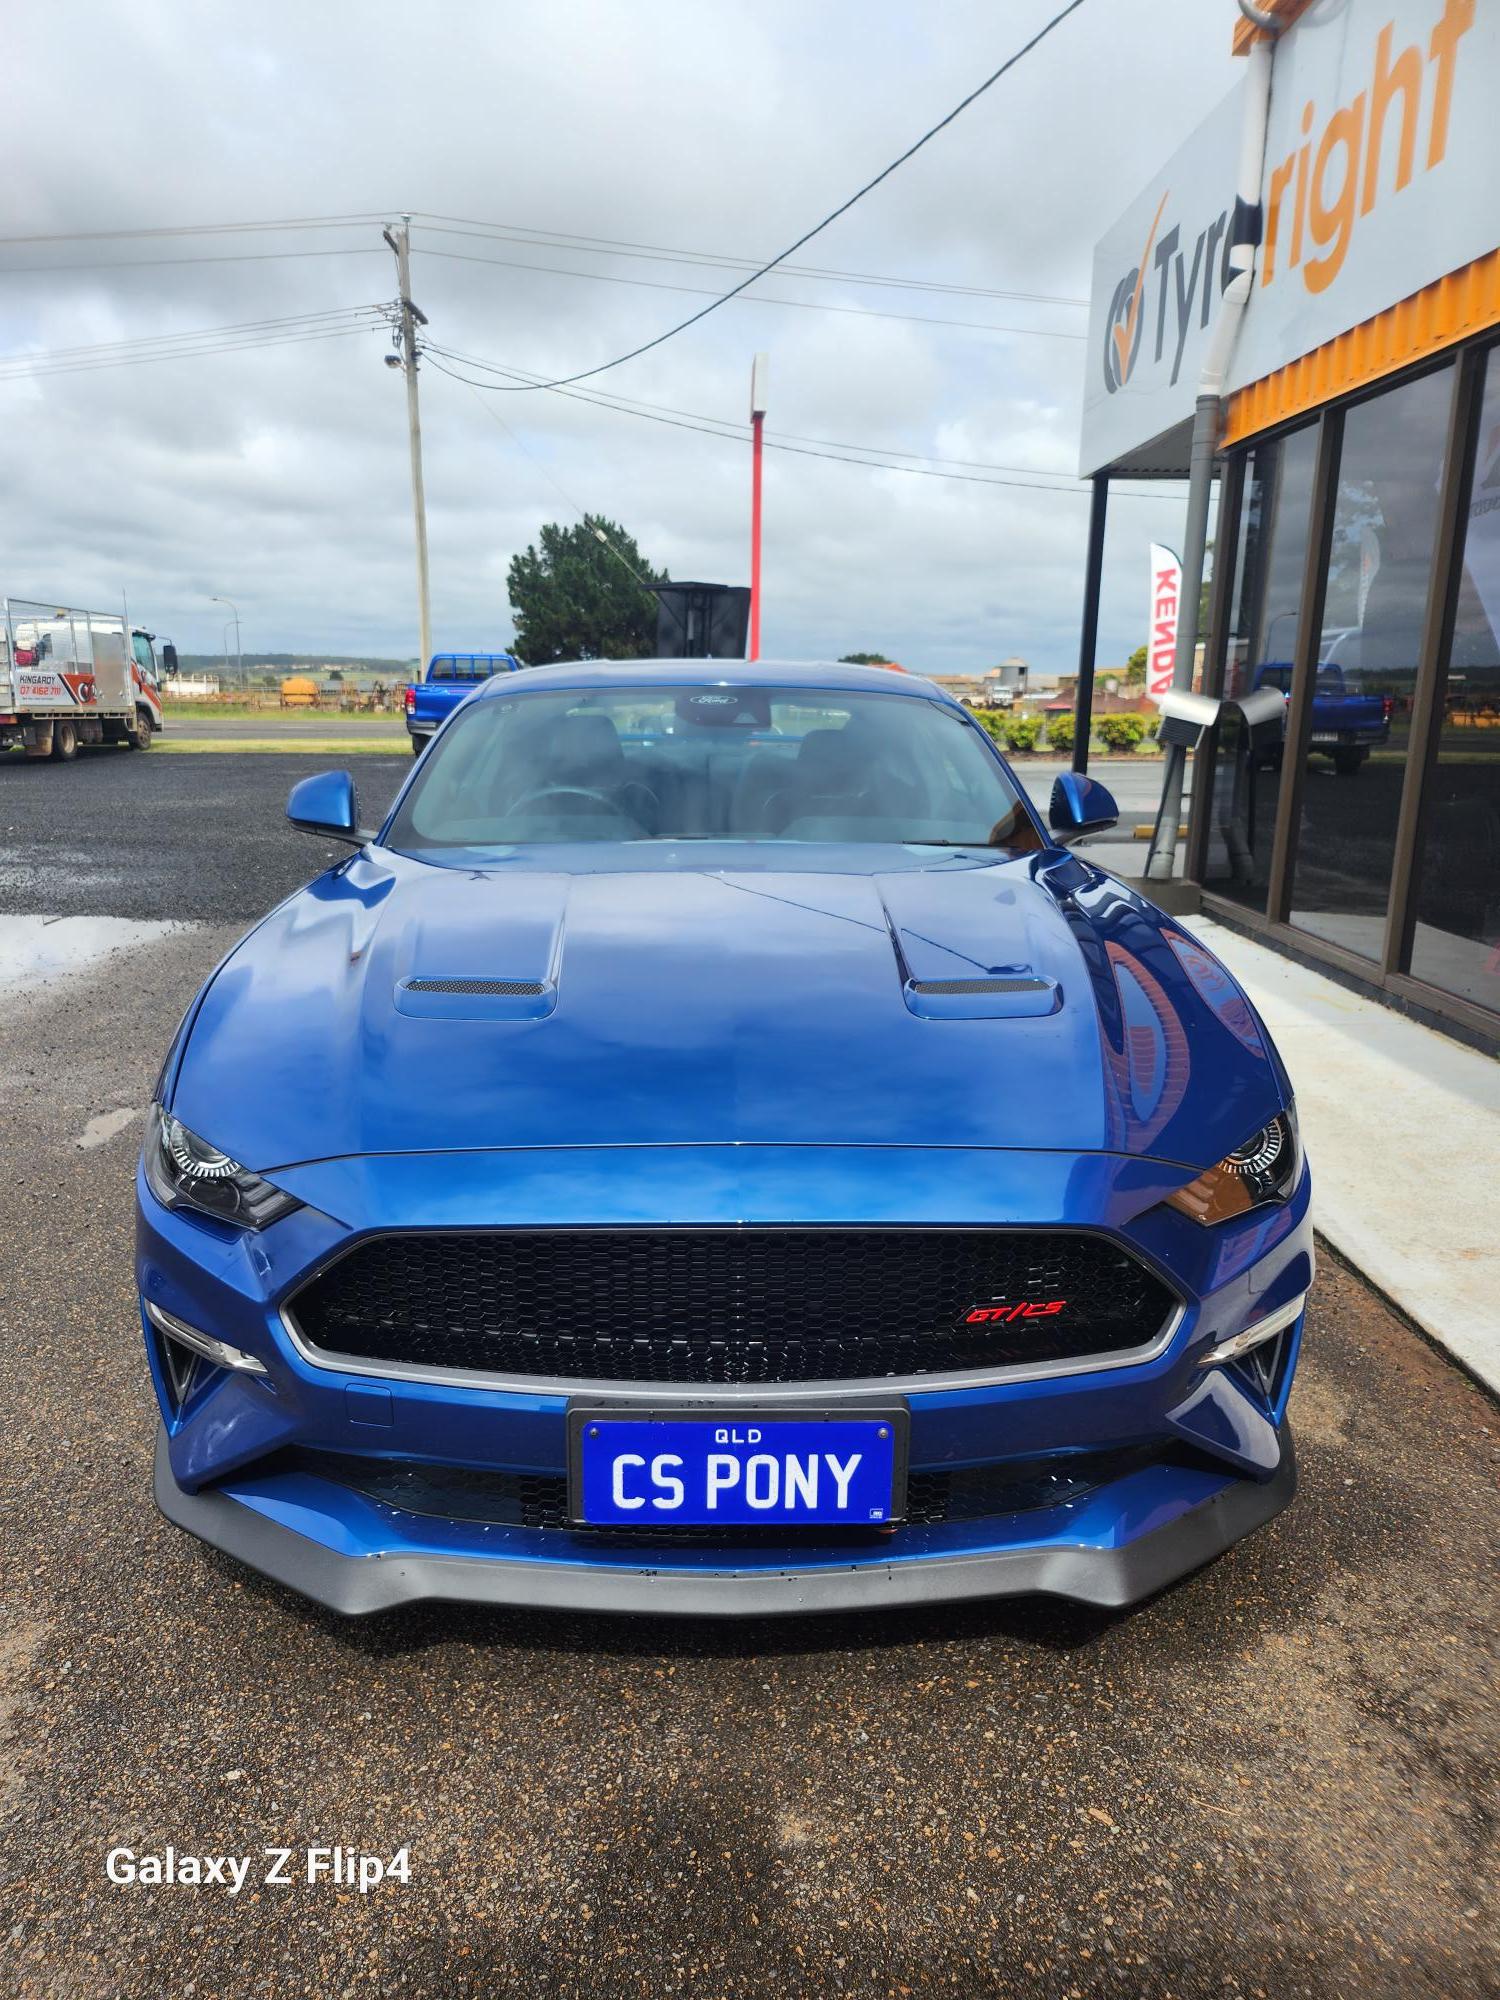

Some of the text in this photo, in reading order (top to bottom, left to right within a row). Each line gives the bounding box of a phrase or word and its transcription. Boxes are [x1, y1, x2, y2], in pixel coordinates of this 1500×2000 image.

[1261, 0, 1476, 295] right
[19, 675, 56, 685] KINGAROY
[20, 686, 30, 695] 07
[715, 1429, 762, 1444] QLD
[612, 1454, 862, 1509] CS PONY
